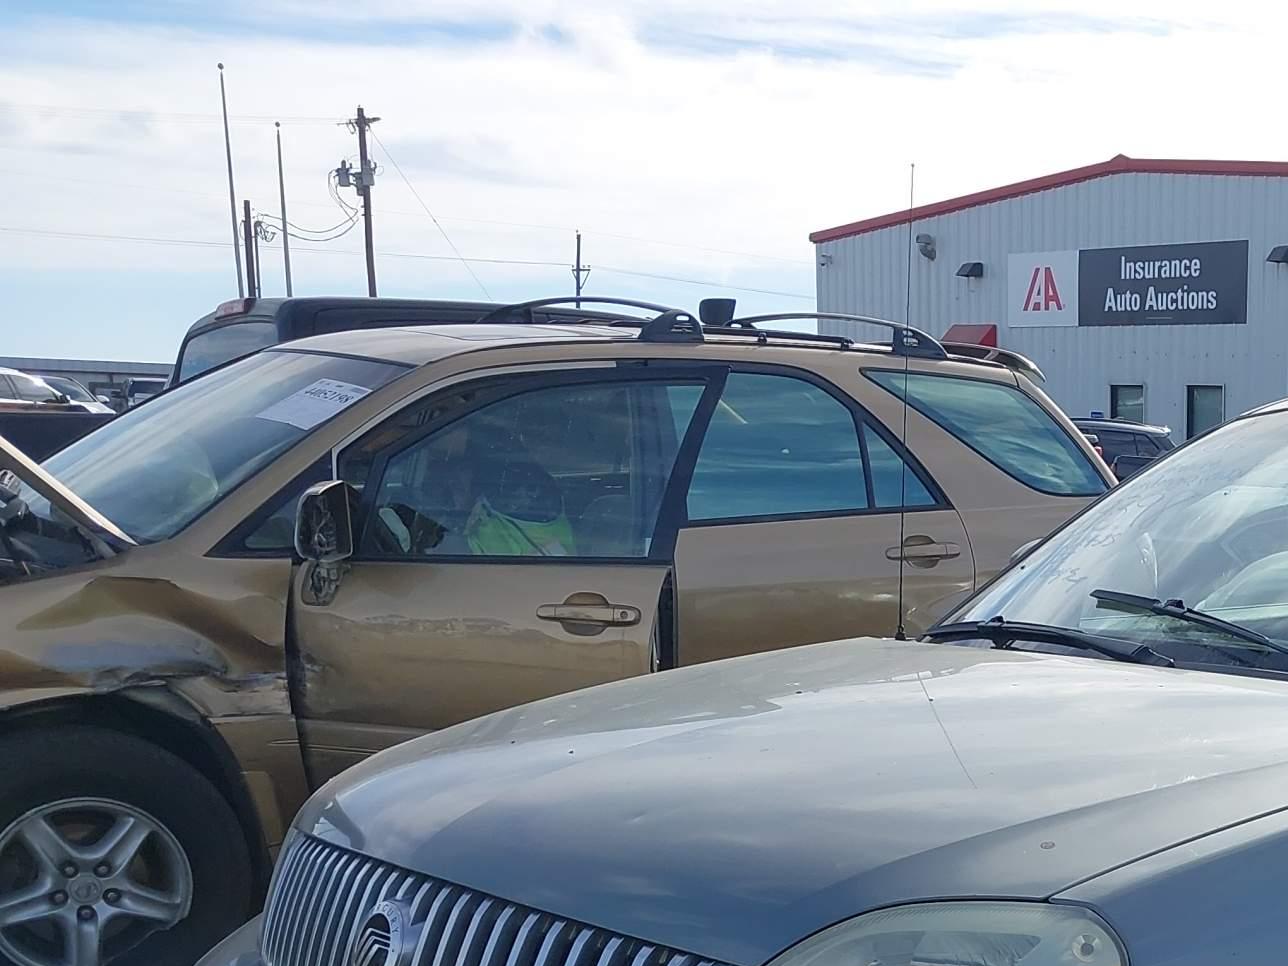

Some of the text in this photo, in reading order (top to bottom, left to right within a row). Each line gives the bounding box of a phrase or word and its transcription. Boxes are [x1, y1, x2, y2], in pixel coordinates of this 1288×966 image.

[1121, 256, 1201, 280] Insurance
[1104, 285, 1217, 312] Auto Auctions
